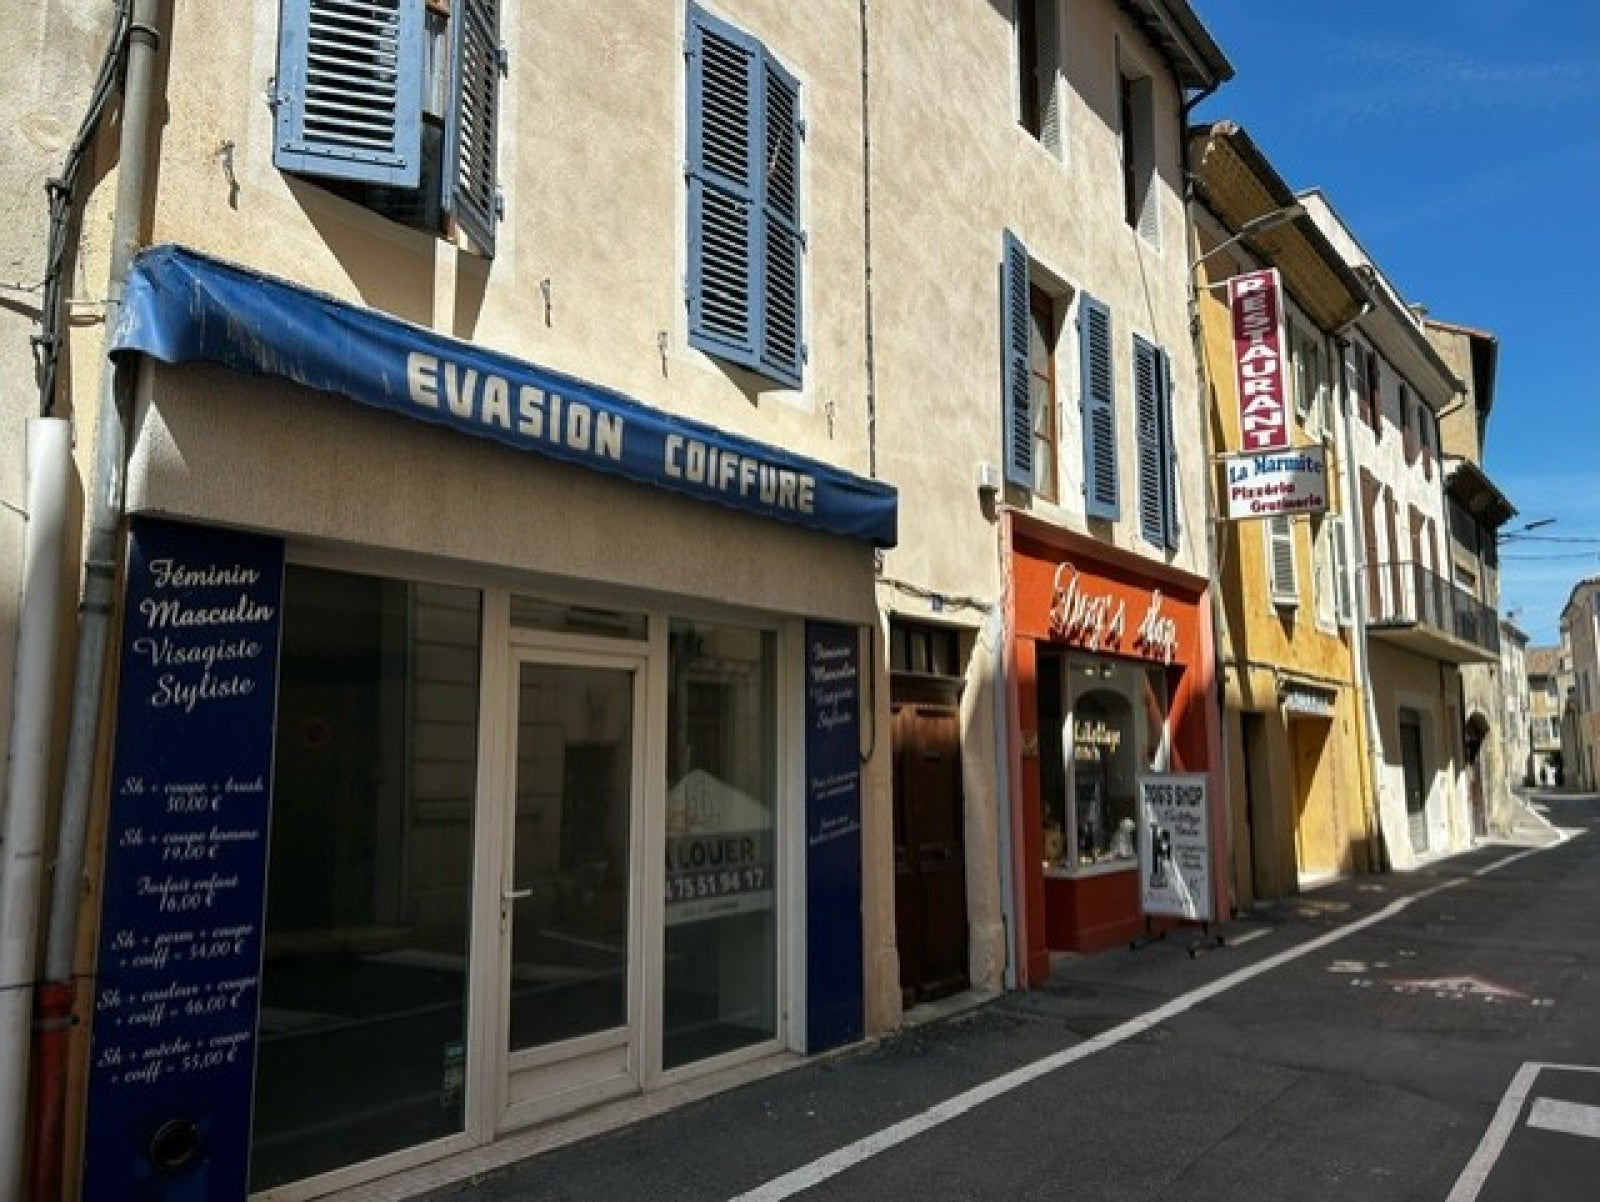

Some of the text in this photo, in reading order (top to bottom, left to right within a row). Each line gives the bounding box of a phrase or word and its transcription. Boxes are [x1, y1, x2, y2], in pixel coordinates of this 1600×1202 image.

[1235, 279, 1284, 446] RESTAURANT
[406, 352, 816, 514] EVASION COIFFURE
[1229, 455, 1322, 483] La Marmite
[149, 559, 260, 588] Féminin
[139, 594, 275, 628] Masculin
[132, 636, 263, 670] Visagiste
[152, 670, 256, 713] Styliste
[678, 837, 756, 868] LOUER
